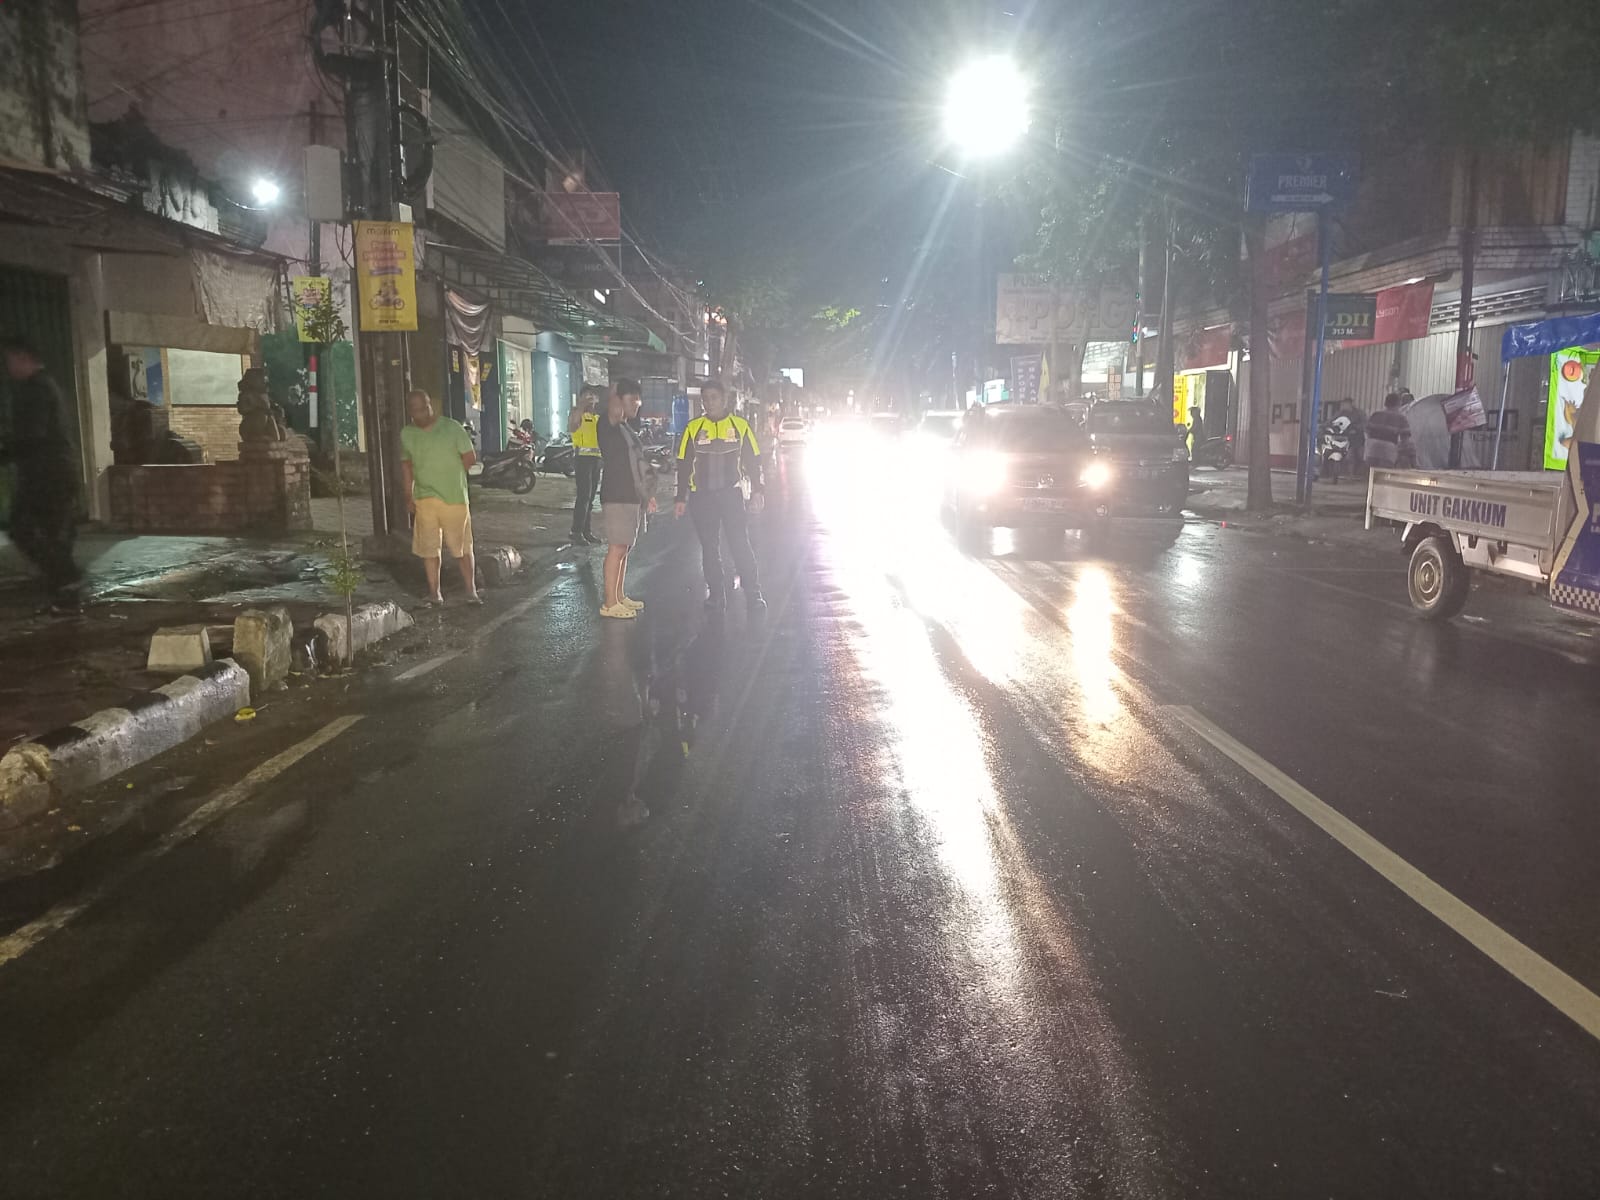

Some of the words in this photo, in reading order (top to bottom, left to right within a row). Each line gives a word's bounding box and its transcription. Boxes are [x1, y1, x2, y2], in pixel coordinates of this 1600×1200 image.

[1278, 175, 1327, 190] PREMIER
[1324, 313, 1370, 327] LDII
[1410, 491, 1440, 516] UNIT
[1441, 496, 1508, 528] GAKKUM
